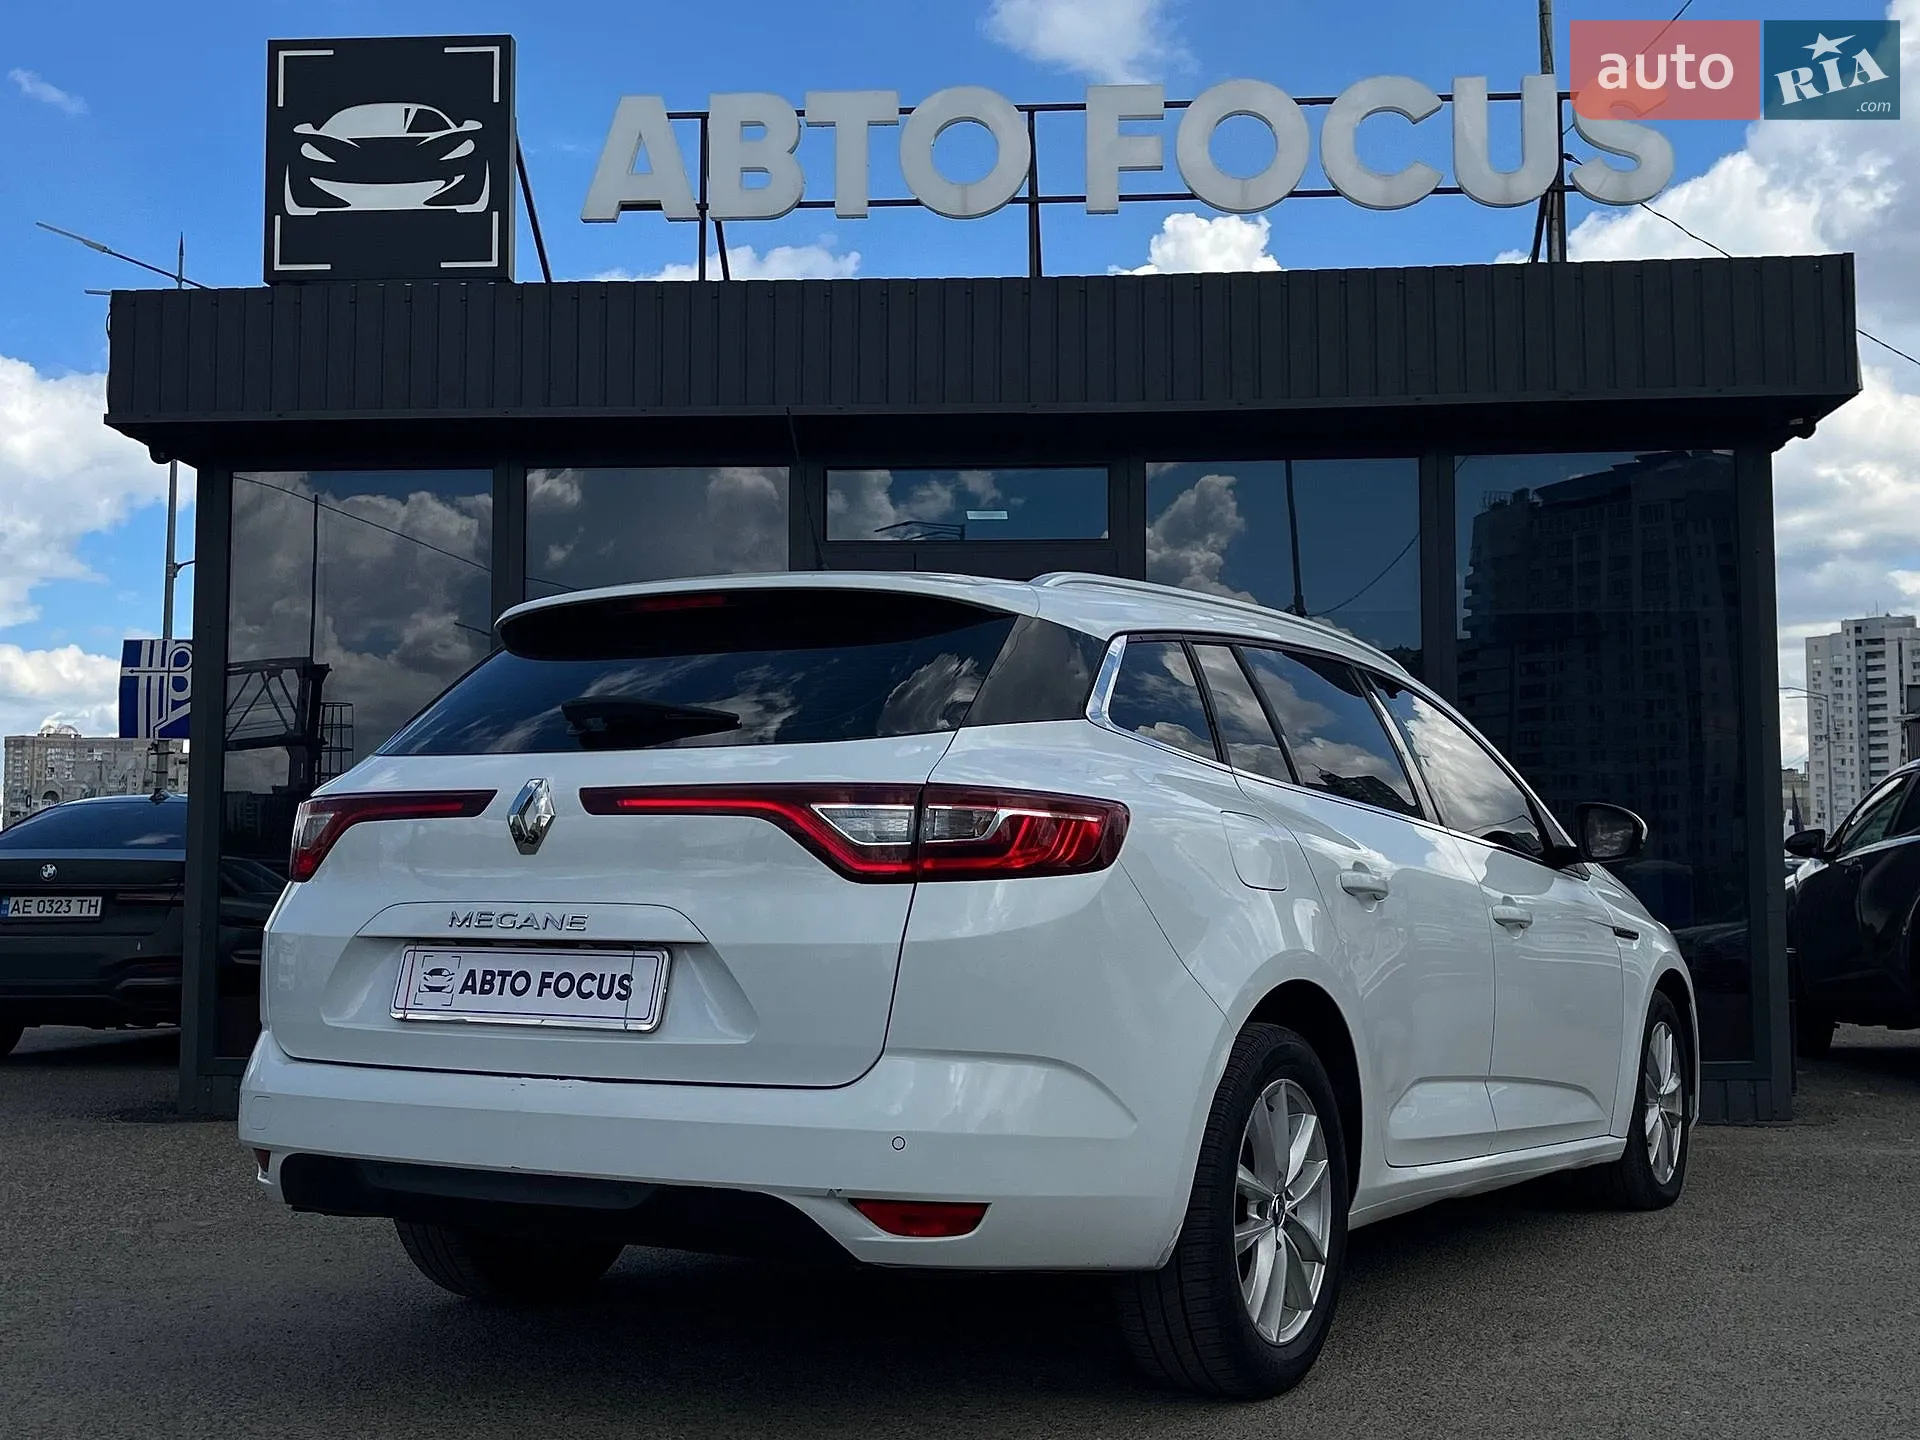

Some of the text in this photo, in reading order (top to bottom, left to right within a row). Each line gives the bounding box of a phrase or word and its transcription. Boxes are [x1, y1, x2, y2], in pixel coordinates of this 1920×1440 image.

[580, 74, 1675, 223] АВТО FOCUS
[37, 899, 72, 914] 0323
[449, 911, 589, 932] MEGANE
[537, 971, 633, 1001] FOCUS
